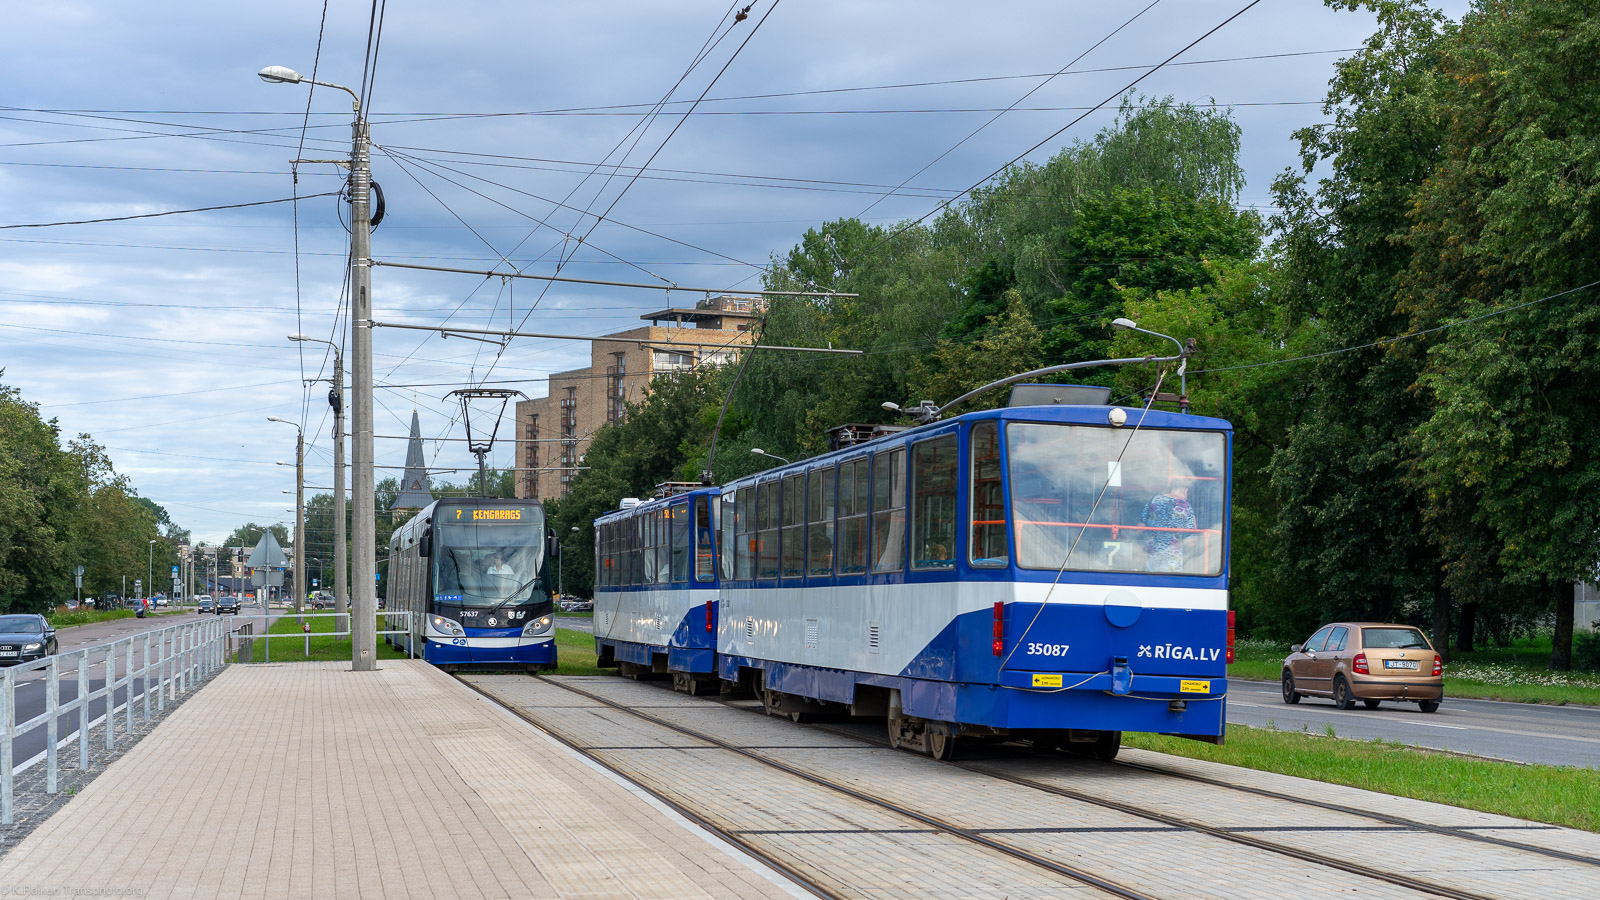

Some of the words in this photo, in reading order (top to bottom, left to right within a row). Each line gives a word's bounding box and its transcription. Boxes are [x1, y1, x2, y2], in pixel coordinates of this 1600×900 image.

[456, 509, 462, 519] 7
[1103, 541, 1121, 566] 7
[1027, 642, 1070, 657] 35087
[1154, 643, 1221, 661] RĪGA.LV
